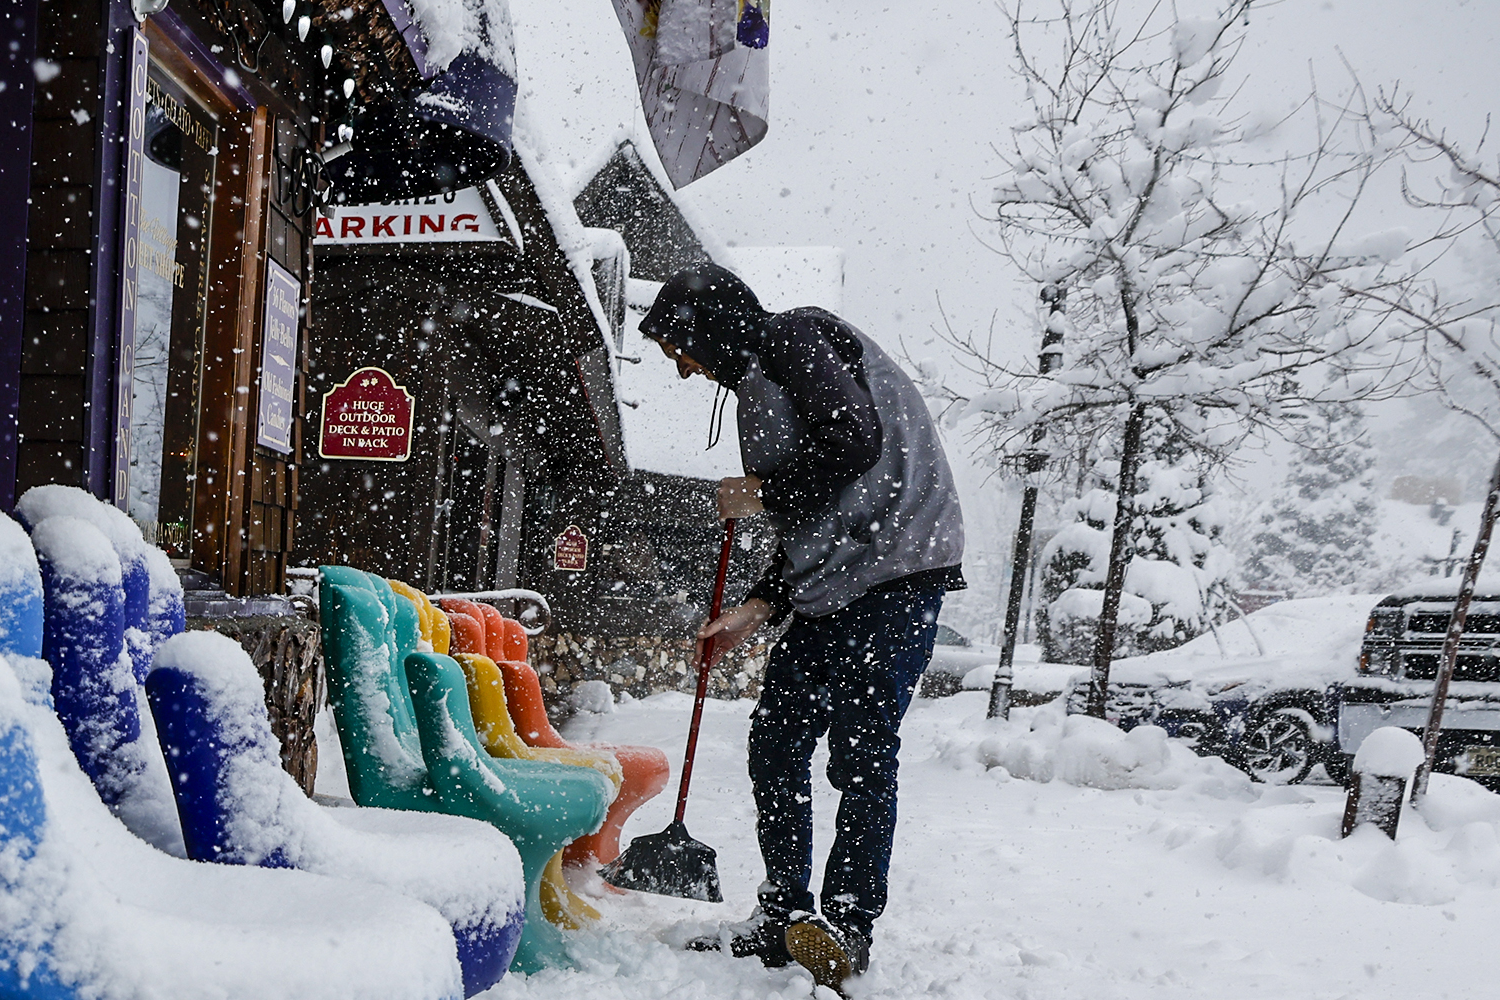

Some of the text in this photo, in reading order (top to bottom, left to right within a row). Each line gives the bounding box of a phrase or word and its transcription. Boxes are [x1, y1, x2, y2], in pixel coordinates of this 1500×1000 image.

[165, 93, 191, 136] GELATO
[125, 63, 144, 310] COTTON
[316, 213, 480, 239] ARKING
[155, 250, 184, 289] SHOPPE
[273, 286, 294, 319] 36 Flavors
[268, 315, 294, 351] Jelly Belly
[263, 370, 292, 403] Old Fashioned
[267, 403, 285, 431] Candies
[339, 412, 397, 424] OUTDOOR
[352, 400, 385, 411] HUGE
[328, 425, 405, 437] DECK & PATIO
[342, 438, 389, 448] IN BACK
